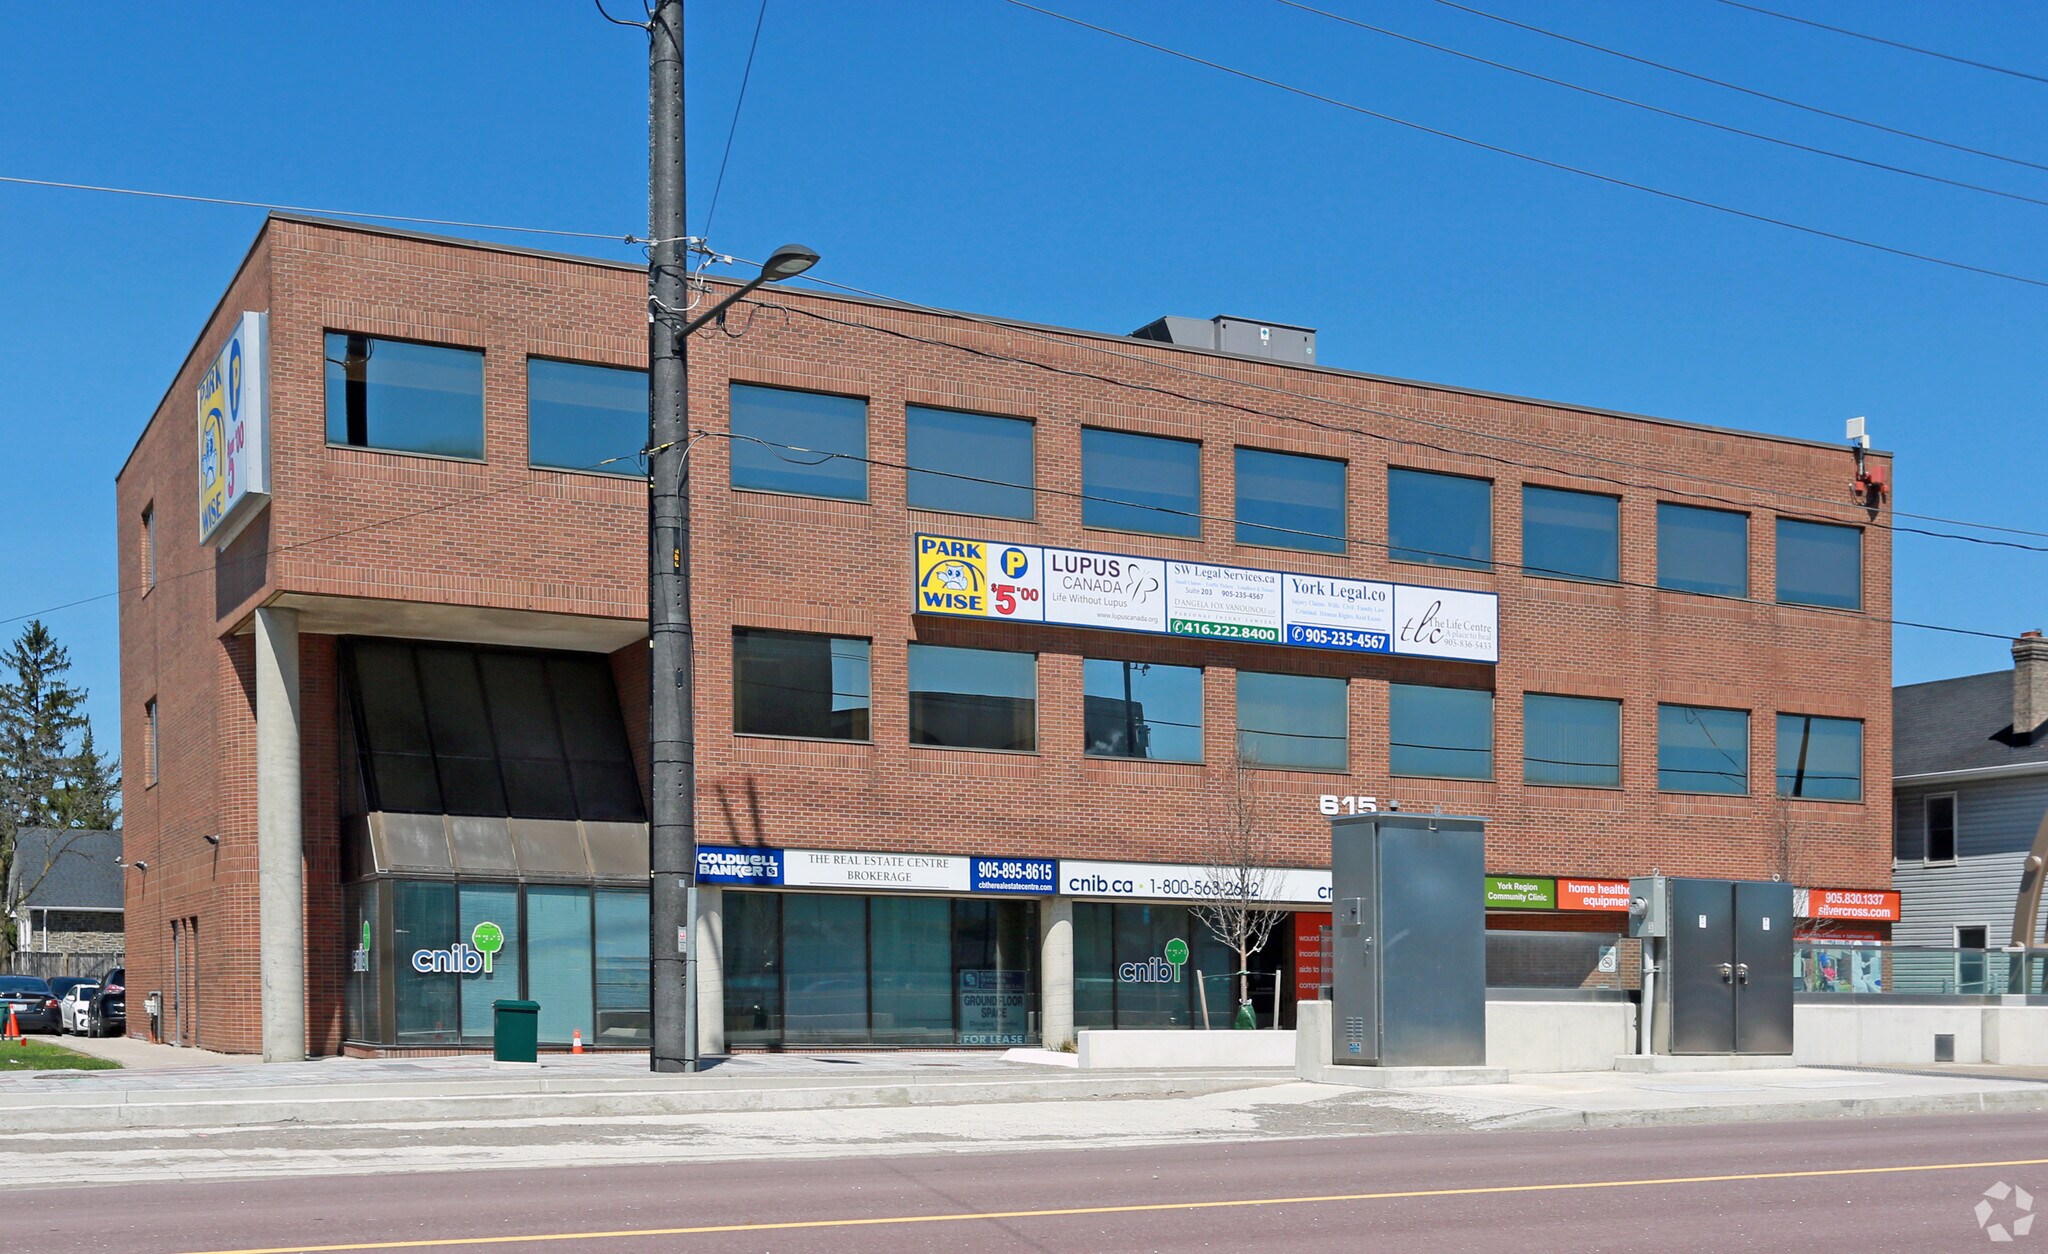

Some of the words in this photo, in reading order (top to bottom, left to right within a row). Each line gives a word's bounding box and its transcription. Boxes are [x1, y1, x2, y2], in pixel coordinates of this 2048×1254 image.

[200, 362, 222, 411] PARK
[202, 491, 221, 535] WISE
[922, 539, 982, 559] PARK
[1052, 554, 1120, 578] LUPUS
[1174, 564, 1192, 575] SW
[1195, 566, 1221, 580] Legal
[1223, 568, 1275, 584] Services.ca
[1062, 575, 1122, 594] CANADA
[1185, 587, 1200, 595] Suite
[1201, 588, 1213, 596] 203
[1292, 578, 1326, 596] York
[1330, 582, 1386, 603] Legal.co
[923, 591, 983, 611] WISE
[1052, 593, 1067, 602] Life
[1069, 594, 1101, 605] Without
[1104, 598, 1128, 608] Lupus
[1221, 590, 1264, 600] 905-235-4567
[1210, 600, 1224, 610] FOX
[1096, 612, 1158, 624] www.lupuscanada.org
[1428, 617, 1444, 628] The
[1446, 618, 1462, 630] Life
[1463, 620, 1492, 633] Centre
[1184, 622, 1276, 640] 416.222.8400
[1452, 631, 1469, 639] place
[1305, 629, 1386, 649] 905-235-4567
[1320, 794, 1377, 815] 615
[697, 853, 779, 867] COLDWELL
[808, 854, 830, 864] THE
[833, 855, 861, 865] REAL
[864, 856, 904, 867] ESTATE
[907, 857, 949, 868] CENTRE
[699, 864, 764, 878] BANKER
[847, 870, 912, 882] BROKERAGE
[978, 861, 1052, 880] 905-895-8615
[978, 881, 1053, 891] cbtherealestatecentre.com
[1069, 874, 1133, 893] cnib.ca
[1150, 878, 1259, 897] 1-800-563-2642
[1496, 882, 1512, 890] York
[1513, 882, 1538, 892] Region
[1568, 882, 1595, 894] home
[1598, 883, 1630, 895] healthc
[1488, 892, 1526, 903] Community
[1528, 893, 1548, 901] Clinic
[1583, 897, 1630, 908] equipmen
[1825, 892, 1884, 905] 905.830.1337
[1818, 904, 1890, 917] silvercross.com
[412, 943, 483, 974] cnib
[1119, 956, 1172, 983] cnib
[963, 995, 997, 1007] GROUND
[963, 1035, 986, 1044] FOR
[990, 1035, 1023, 1044] LEASE
